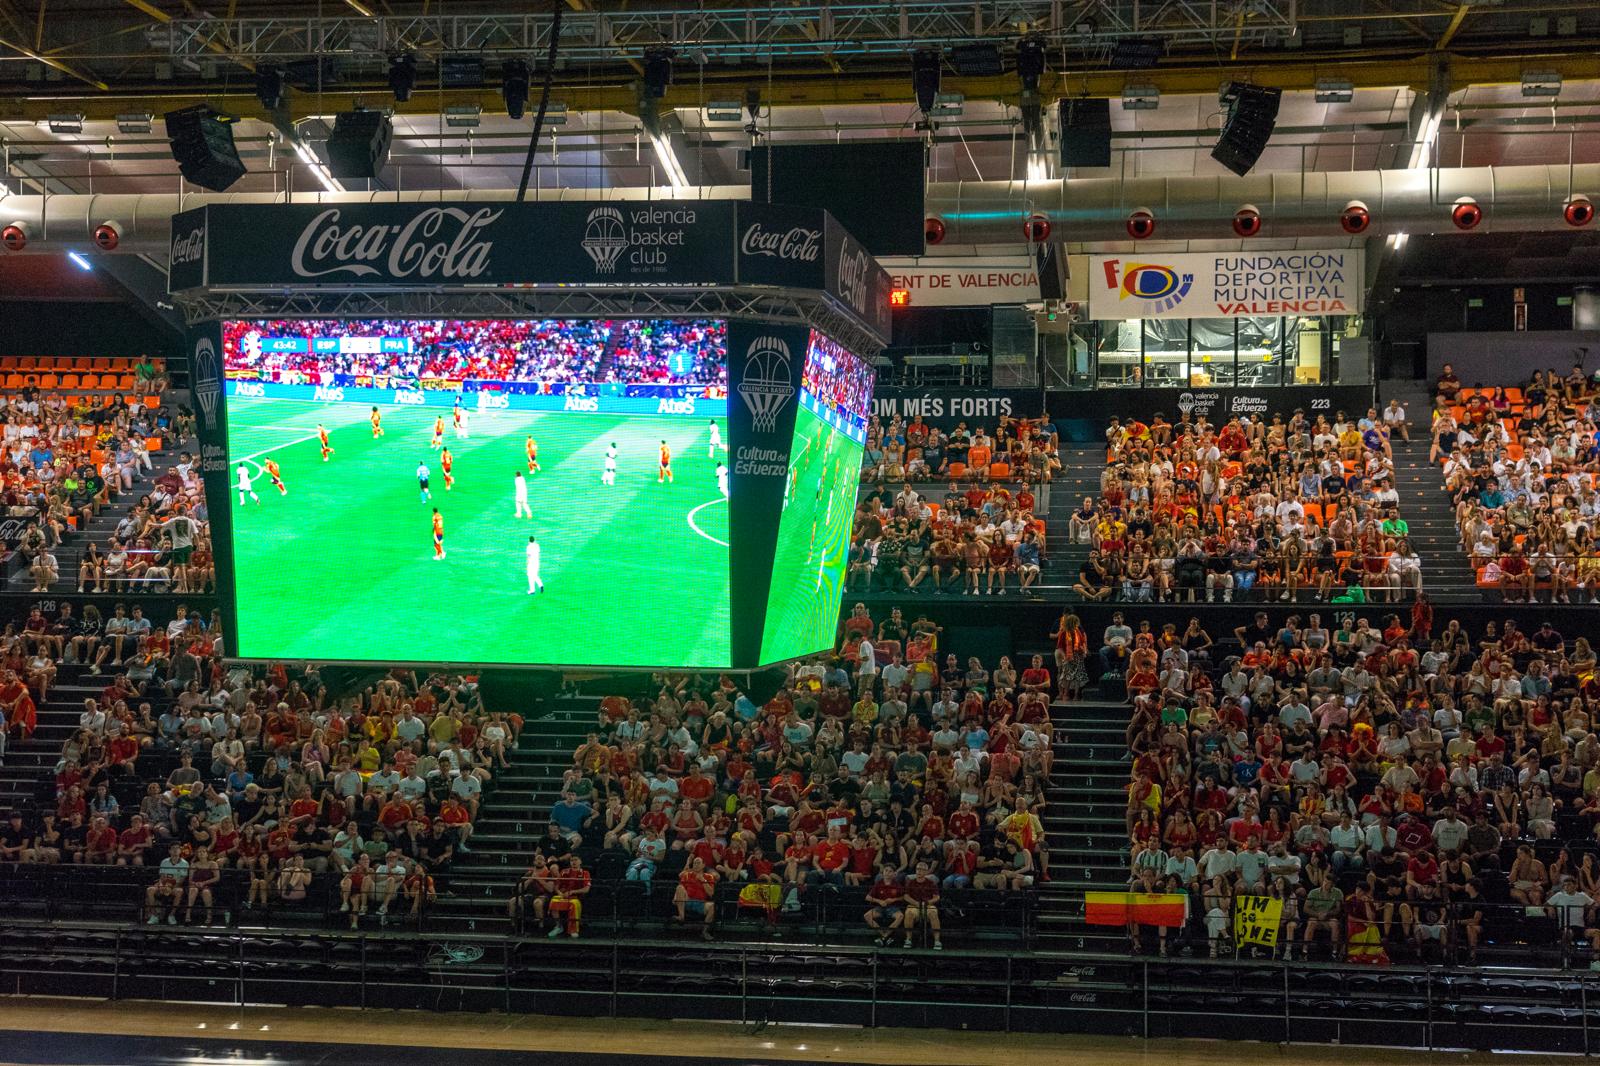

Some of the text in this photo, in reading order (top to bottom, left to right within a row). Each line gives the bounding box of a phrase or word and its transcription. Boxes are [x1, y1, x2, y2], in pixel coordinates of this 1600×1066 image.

[631, 206, 696, 224] valencia
[291, 208, 504, 277] Coca-Cola
[631, 227, 685, 245] basket
[742, 223, 823, 262] Coca-Cola
[631, 247, 667, 264] club
[1215, 252, 1343, 271] FUNDACIÓN
[929, 275, 951, 288] DE
[958, 273, 1038, 288] VALENCIA
[1214, 270, 1344, 286] DEPORTIVA
[1214, 285, 1345, 302] MUNICIPAL
[1216, 300, 1347, 315] VALENCIA
[904, 393, 944, 417] MÉS
[950, 397, 1013, 417] FORTS
[1231, 403, 1268, 412] Esfuerzo
[1232, 395, 1261, 404] Cultura
[1311, 398, 1331, 409] 223
[736, 445, 778, 460] Cultura
[734, 461, 787, 477] Esfuerzo
[39, 600, 57, 612] 126
